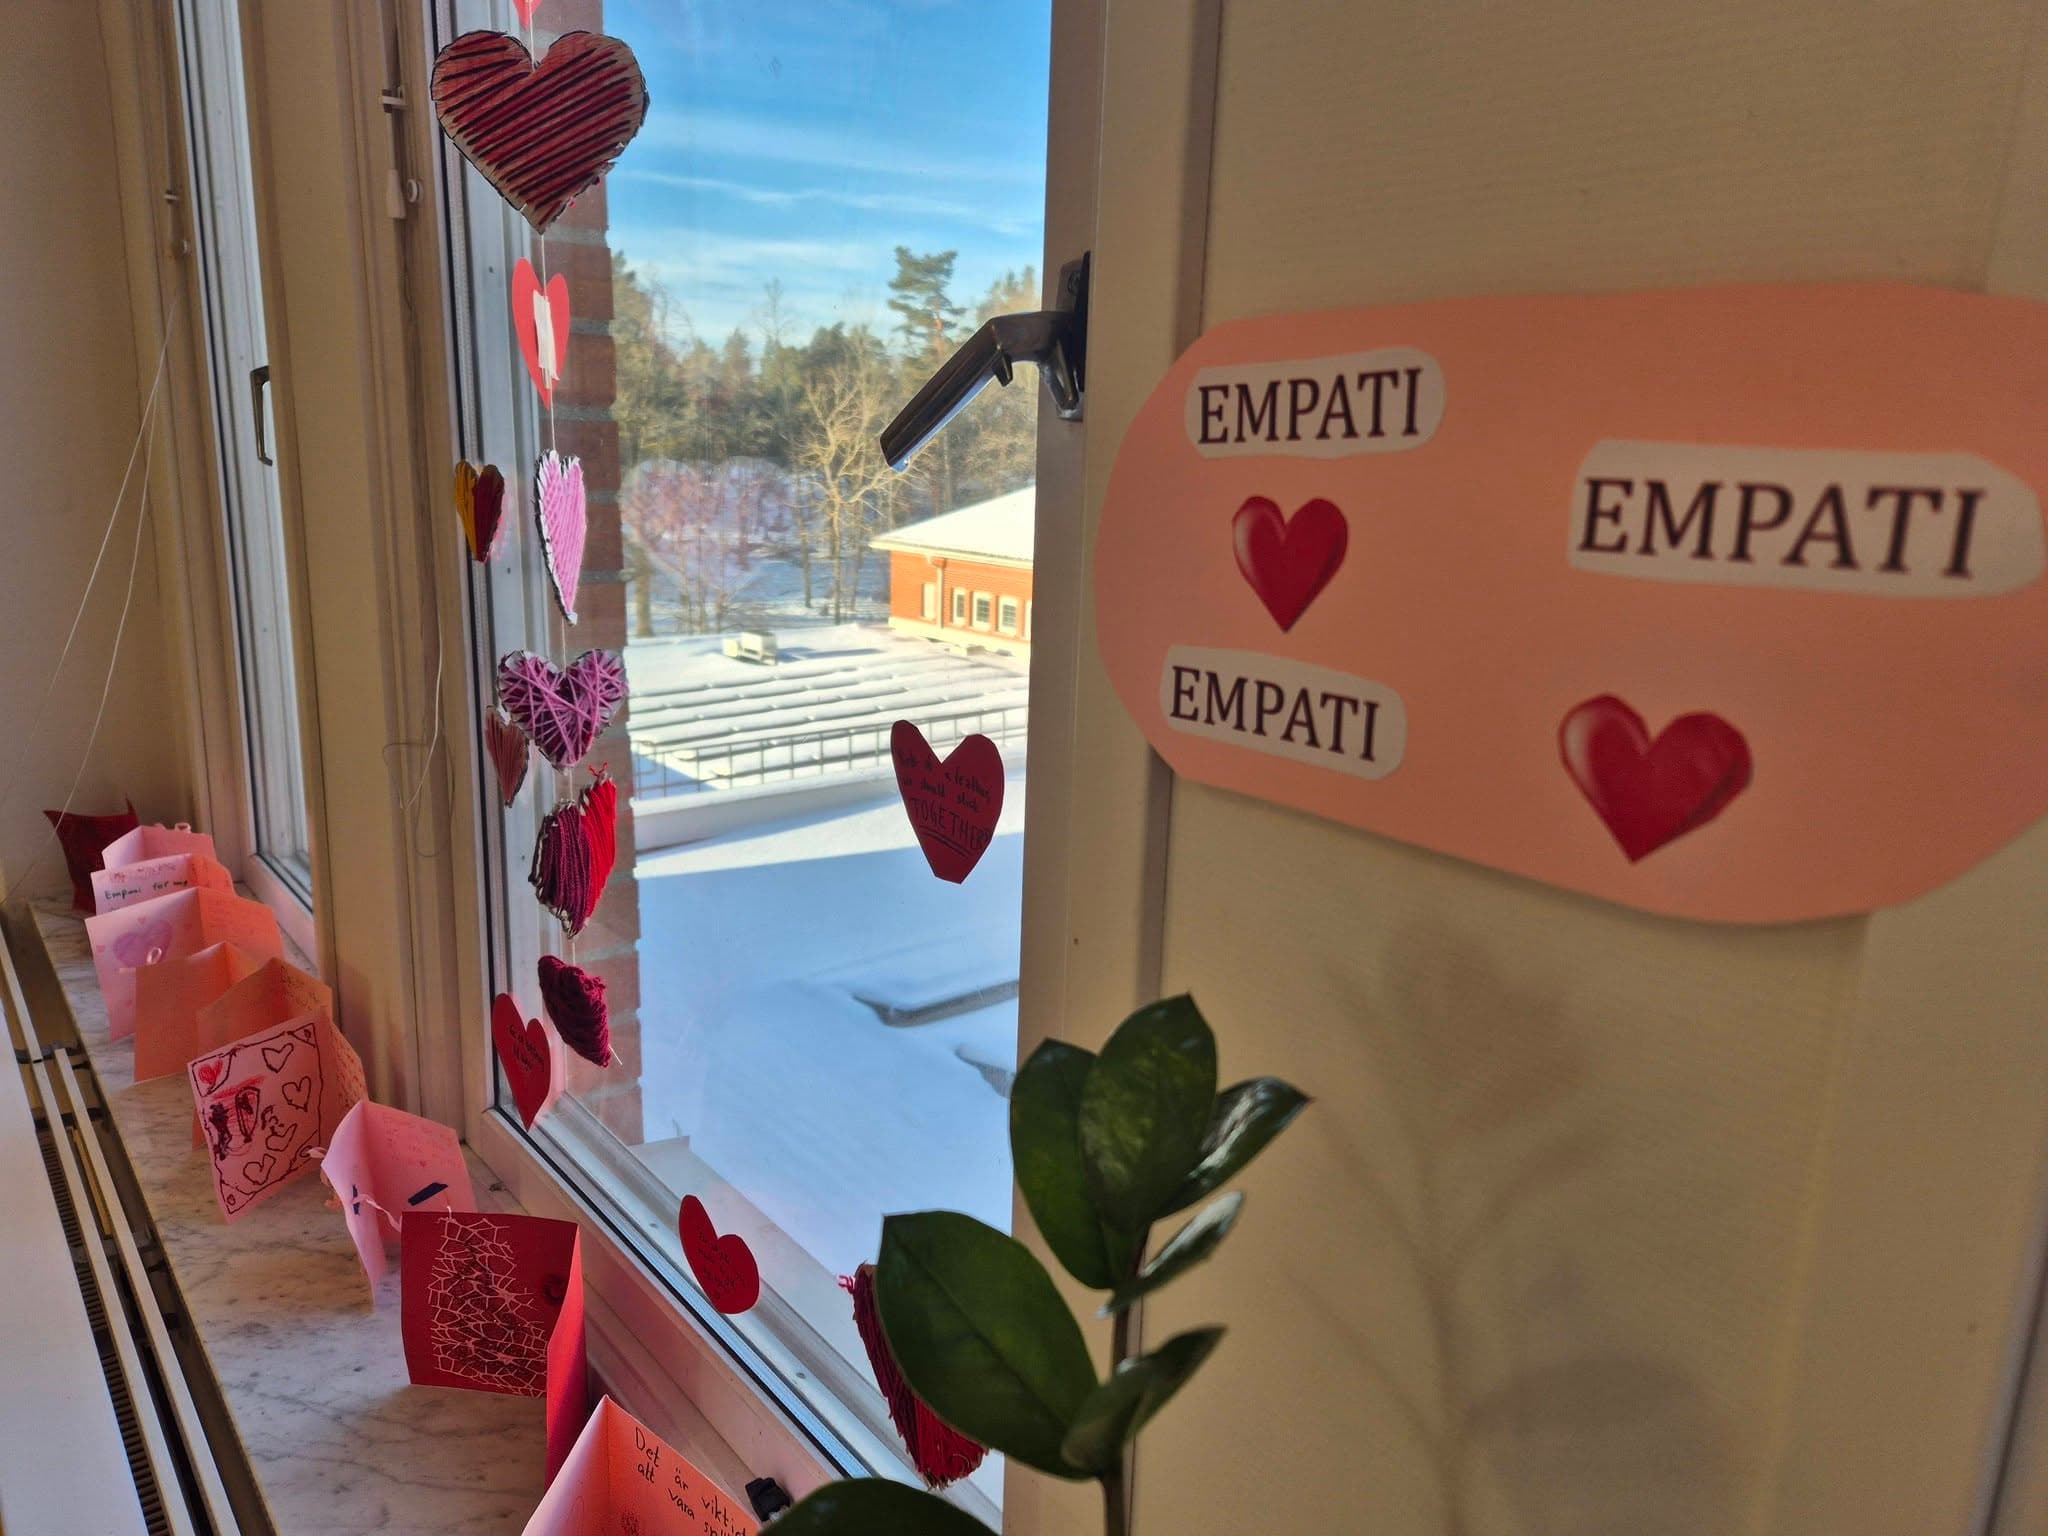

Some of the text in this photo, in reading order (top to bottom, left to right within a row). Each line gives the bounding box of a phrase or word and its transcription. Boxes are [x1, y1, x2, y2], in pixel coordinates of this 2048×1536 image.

[1198, 366, 1424, 446] EMPATI
[1577, 476, 1988, 581] EMPATI
[1169, 664, 1382, 764] EMPATI
[634, 1426, 660, 1468] Det
[675, 1466, 689, 1491] är
[637, 1462, 696, 1521] att vara
